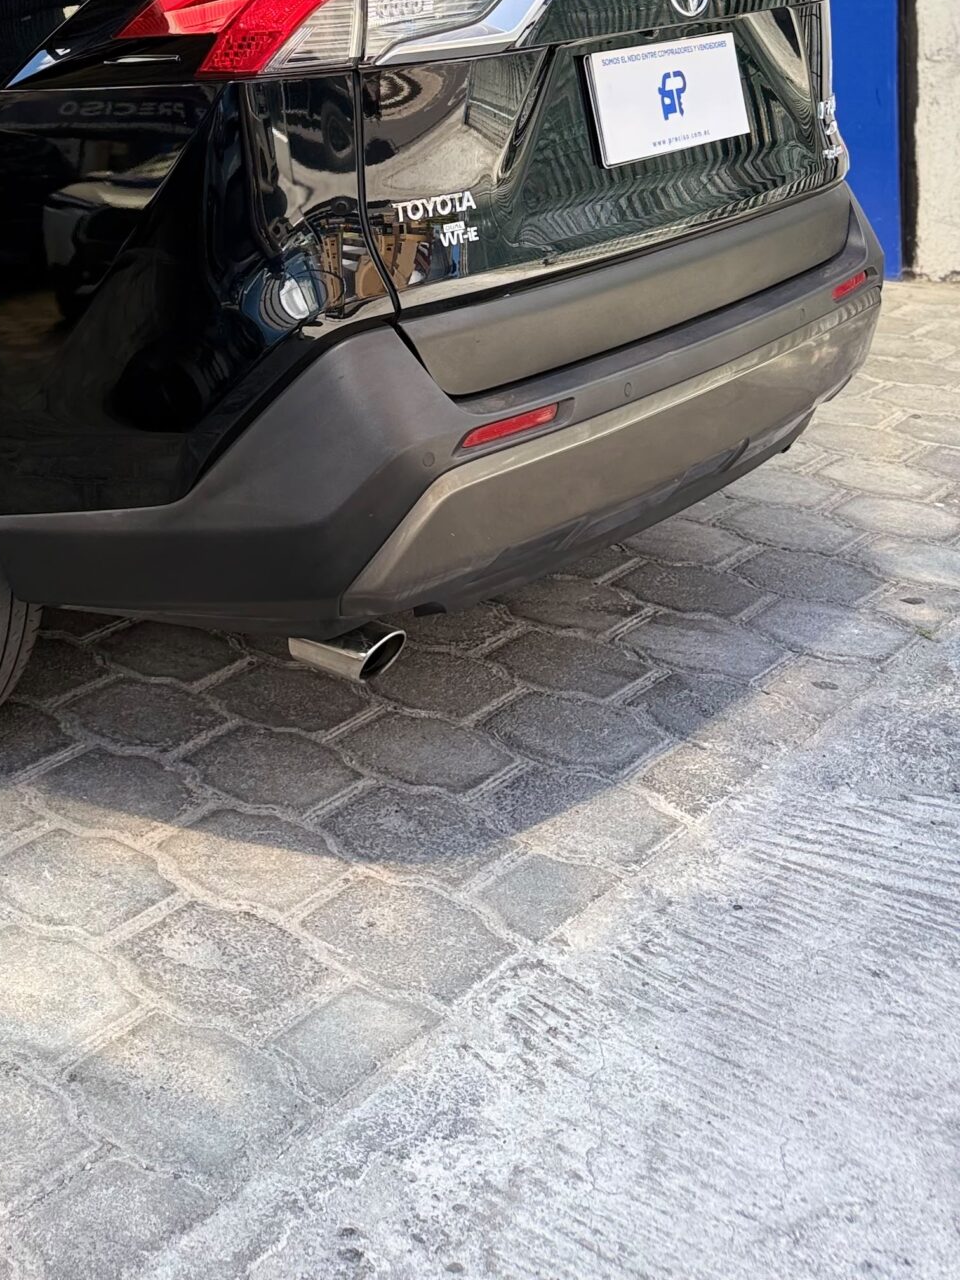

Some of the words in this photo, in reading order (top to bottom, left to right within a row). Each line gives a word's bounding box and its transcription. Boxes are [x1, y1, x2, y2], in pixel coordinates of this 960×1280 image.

[601, 56, 621, 67] SOMOS
[620, 55, 628, 64] EL
[627, 53, 641, 63] NEXO
[641, 51, 657, 61] ENTRE
[657, 46, 693, 59] COMPRADORES
[697, 40, 727, 52] VENDEDORES
[652, 129, 711, 147] www.preciso.com.ec
[391, 191, 477, 222] TOYOTA
